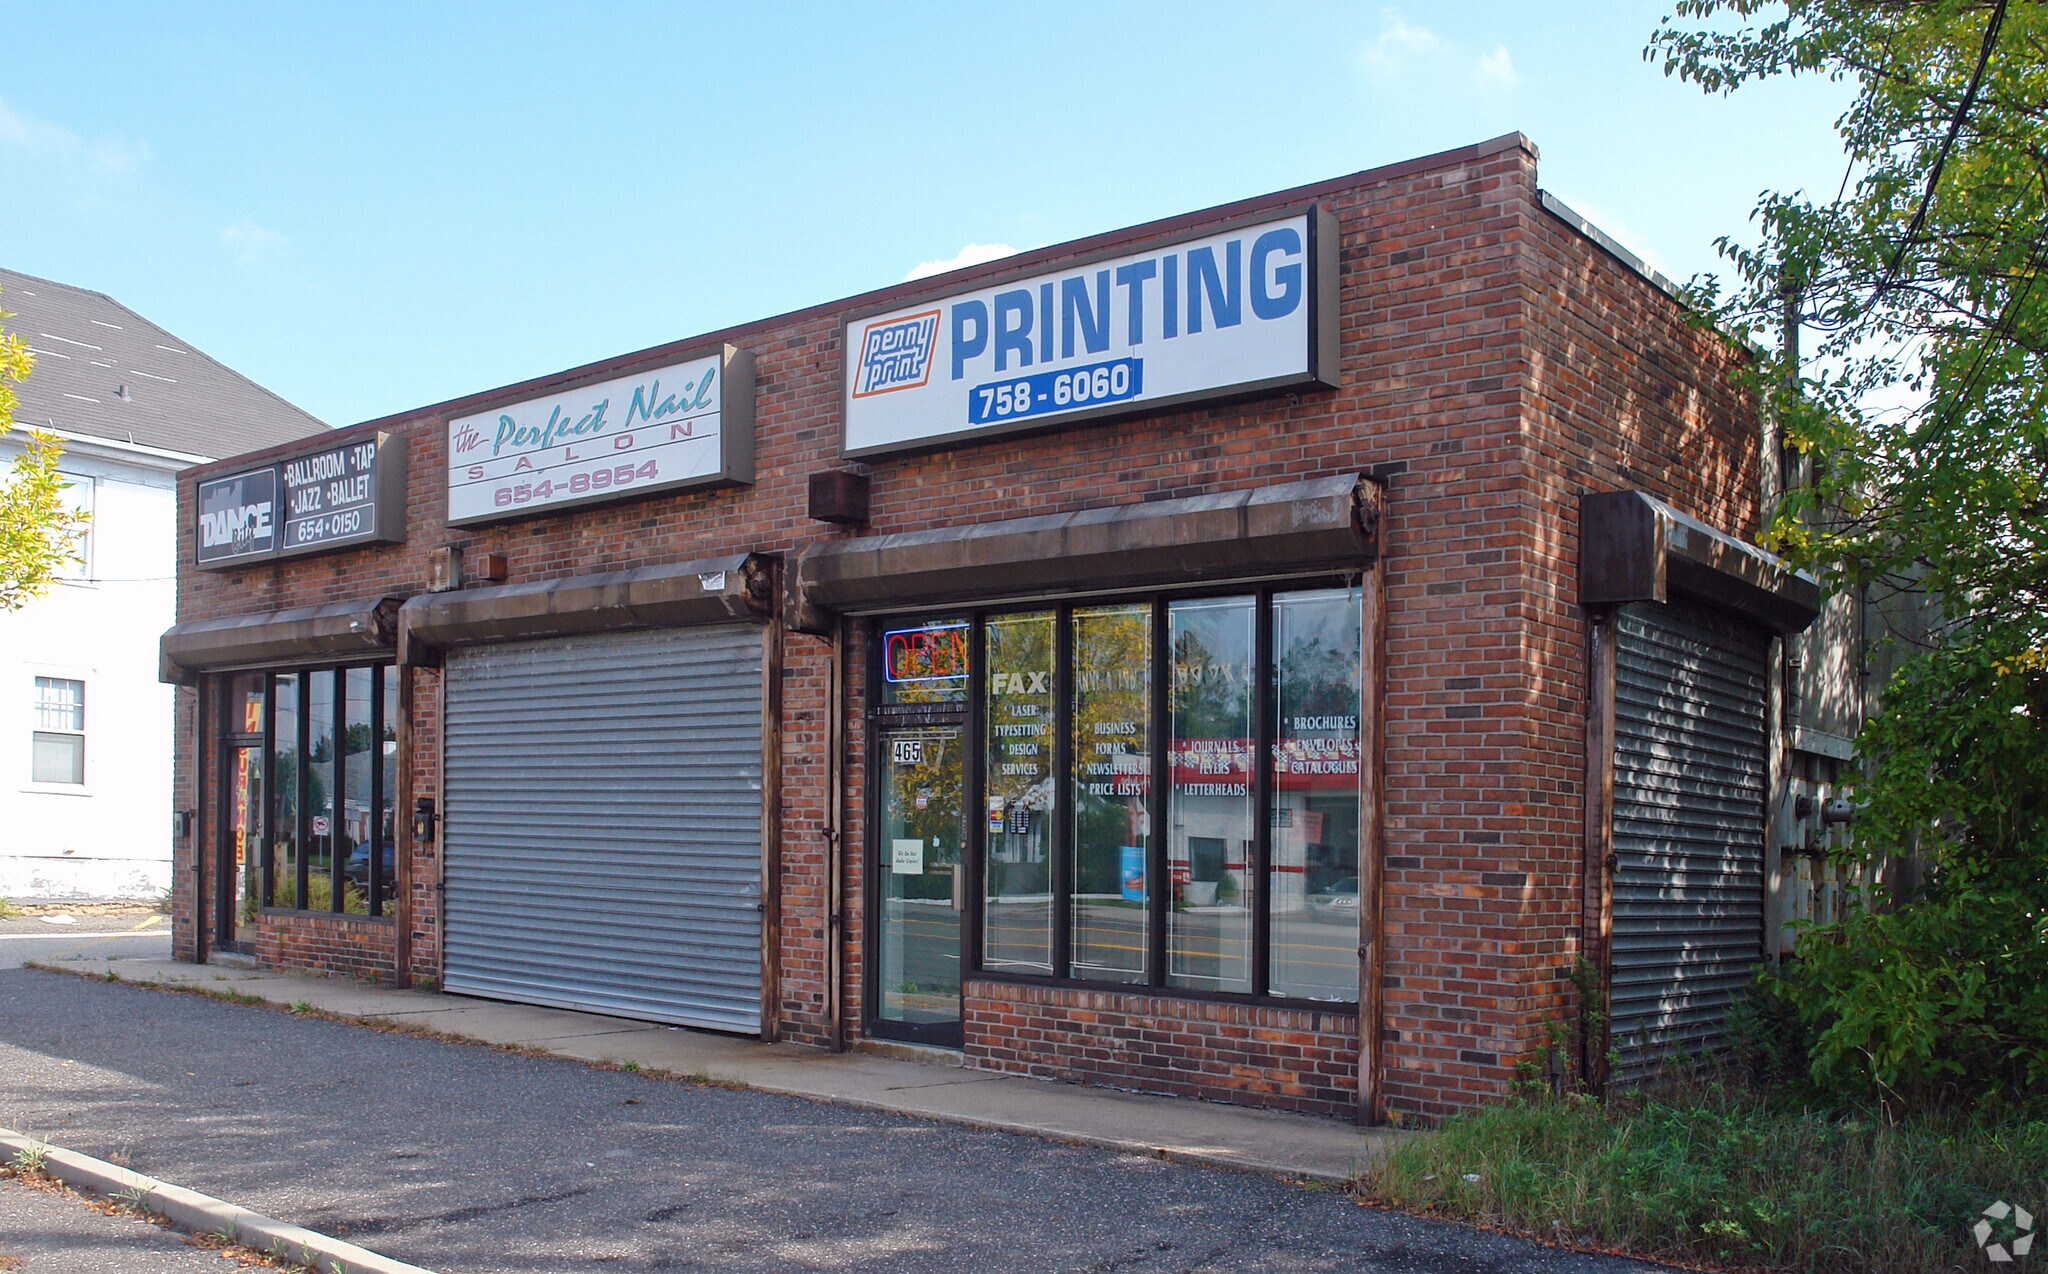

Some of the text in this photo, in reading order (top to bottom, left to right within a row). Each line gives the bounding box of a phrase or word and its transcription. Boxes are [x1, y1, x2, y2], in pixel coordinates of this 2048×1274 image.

[951, 228, 1302, 380] PRINTING
[866, 317, 935, 366] penny
[453, 367, 716, 455] the Perfect Nail
[287, 443, 375, 488] BALLROOM TAP
[494, 459, 658, 507] 654-8954
[295, 474, 370, 514] JAZZ BALLET
[200, 501, 272, 547] DANCE
[888, 631, 970, 677] OPEN
[992, 671, 1047, 695] FAX
[1011, 704, 1037, 717] LASER
[994, 723, 1047, 737] TYPESETTING
[1094, 721, 1135, 735] BUSINESS
[1293, 715, 1356, 730] BROCHURES
[895, 742, 920, 761] 465
[1009, 743, 1038, 755] DESIGN
[1095, 742, 1126, 755] FORMS
[1191, 740, 1239, 754] JOURNALS
[1296, 738, 1353, 752] ENVELOPES
[1001, 763, 1038, 775] SERVICES
[1086, 762, 1144, 776] NEWSLETTERS
[1199, 760, 1230, 775] FLYERS
[1291, 760, 1358, 775] CATALOGUES
[1089, 782, 1142, 796] PRICE LISTS
[1184, 782, 1247, 797] LETTERHEADS
